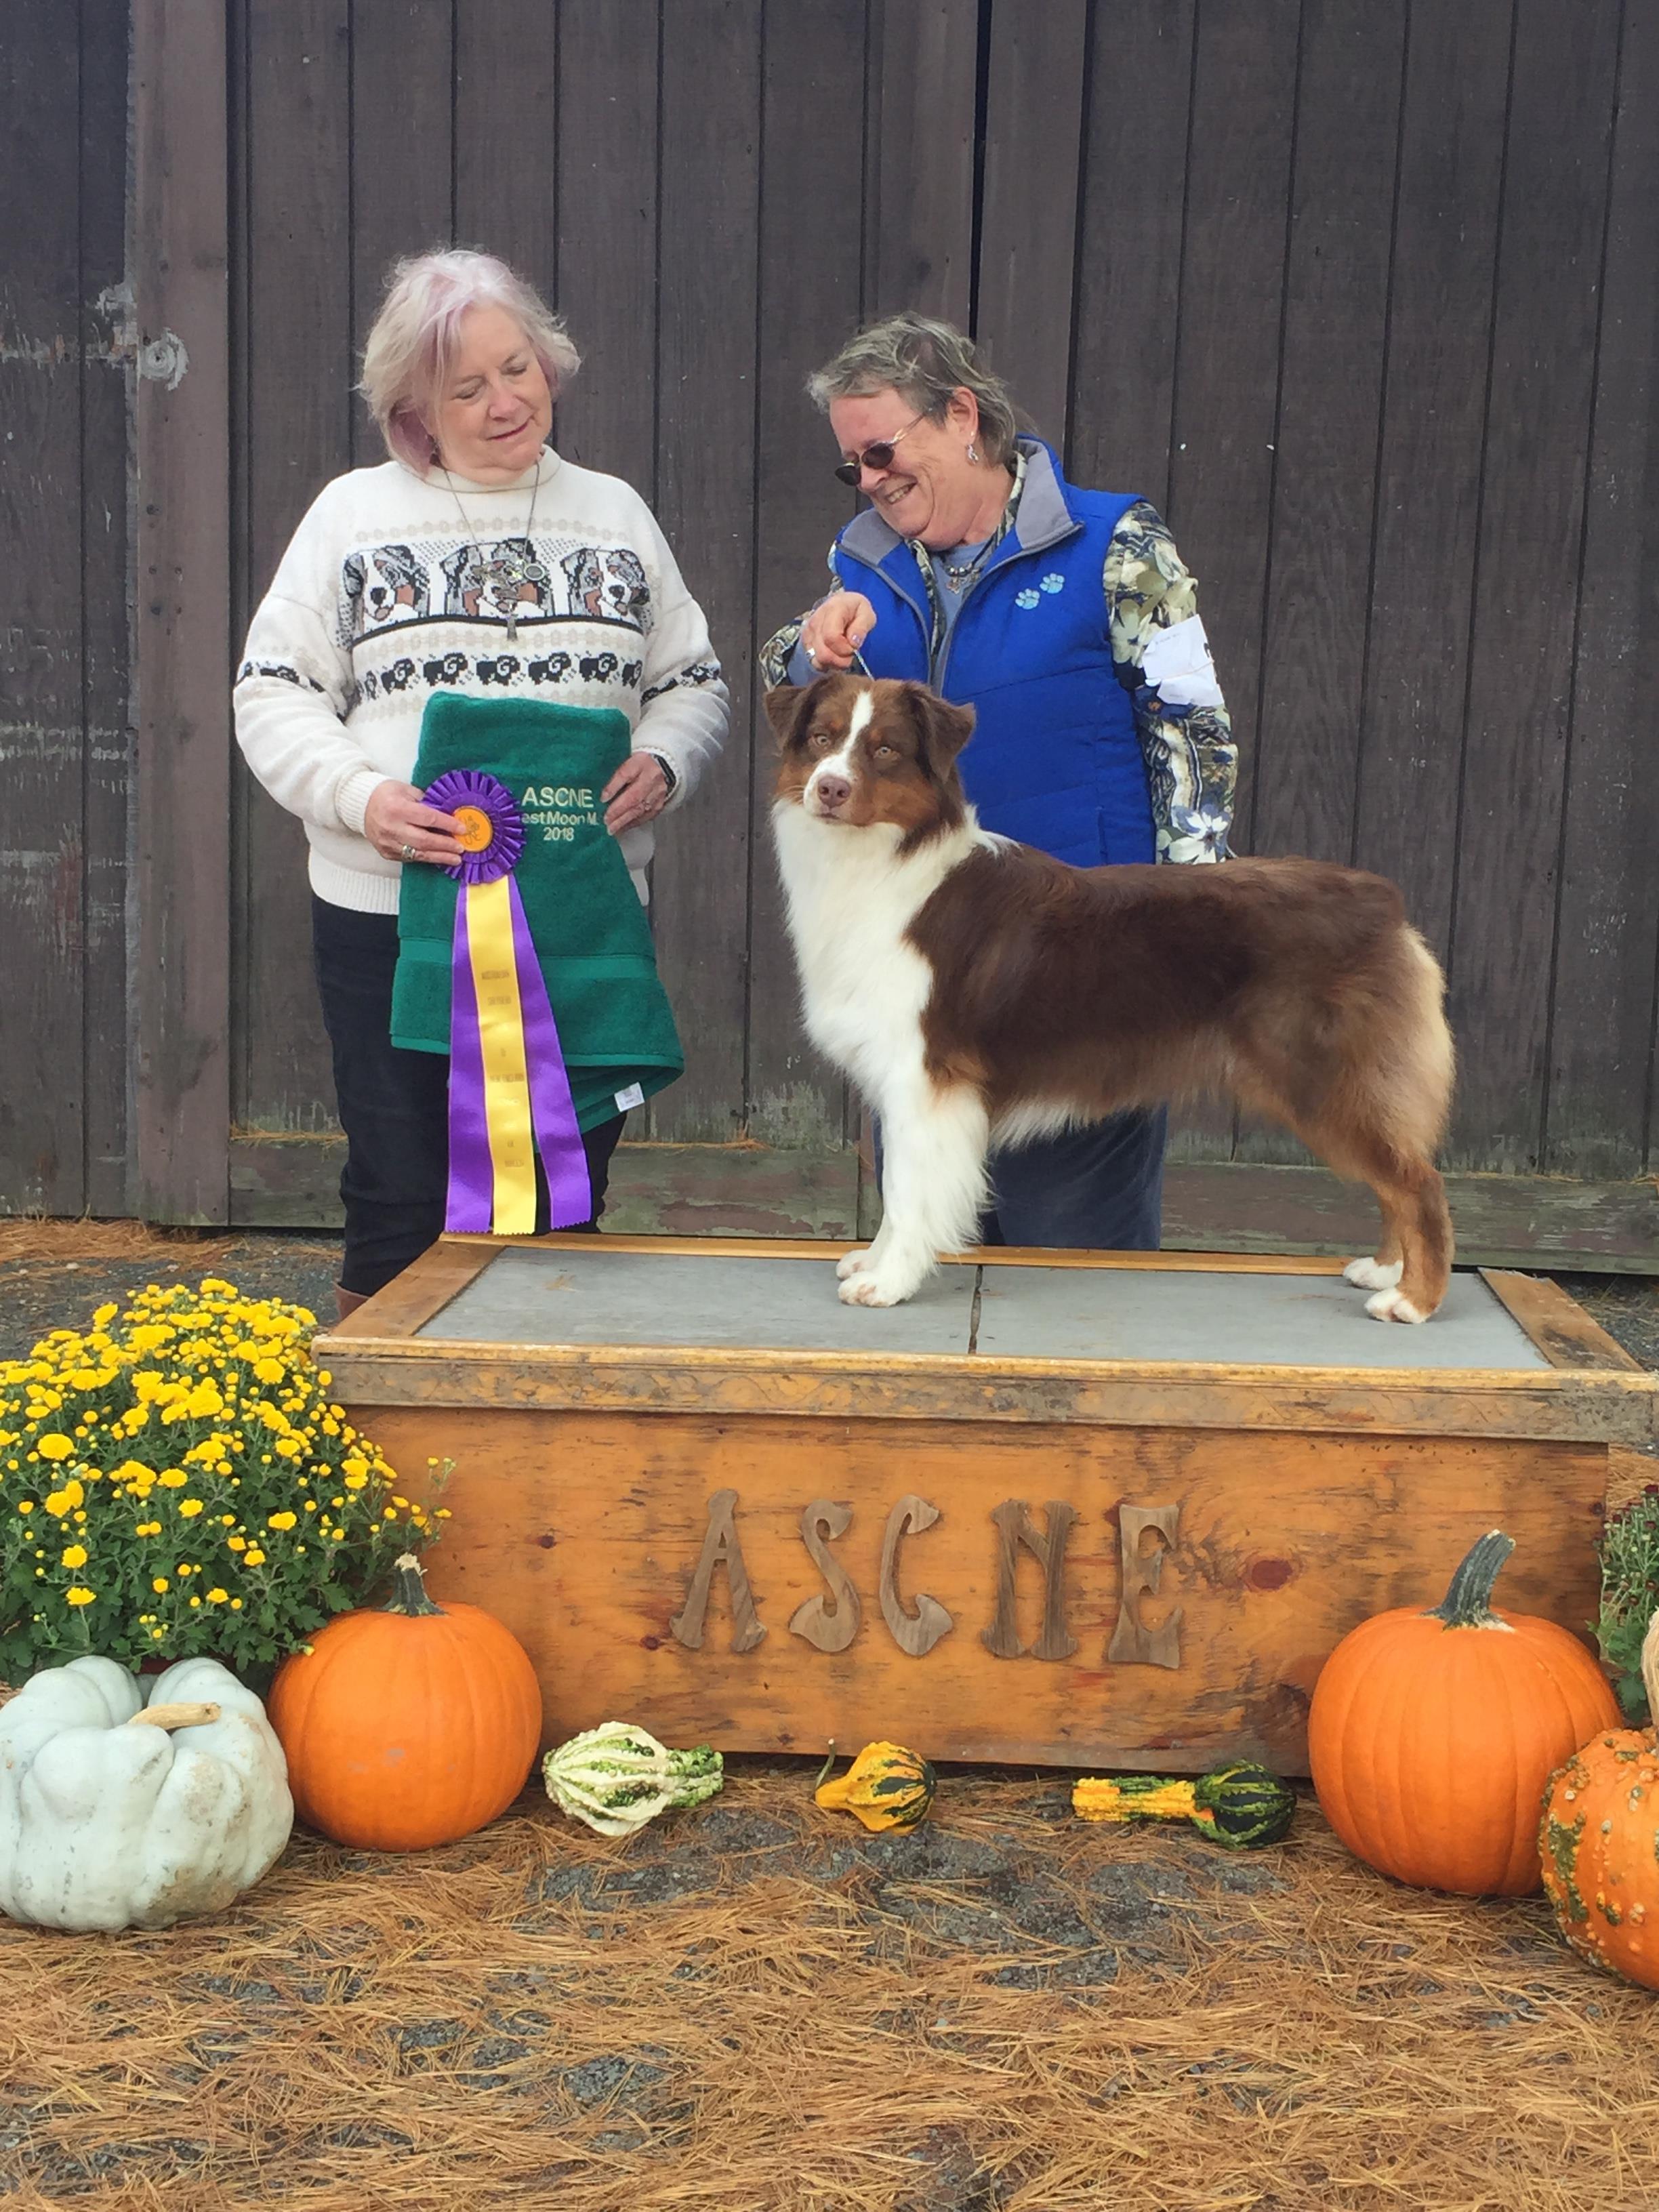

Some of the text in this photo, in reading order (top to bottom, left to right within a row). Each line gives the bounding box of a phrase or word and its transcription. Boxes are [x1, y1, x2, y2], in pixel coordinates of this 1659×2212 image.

[521, 787, 594, 808] ASCNE
[544, 827, 575, 842] 2018
[668, 1490, 1181, 1670] ASCNE
